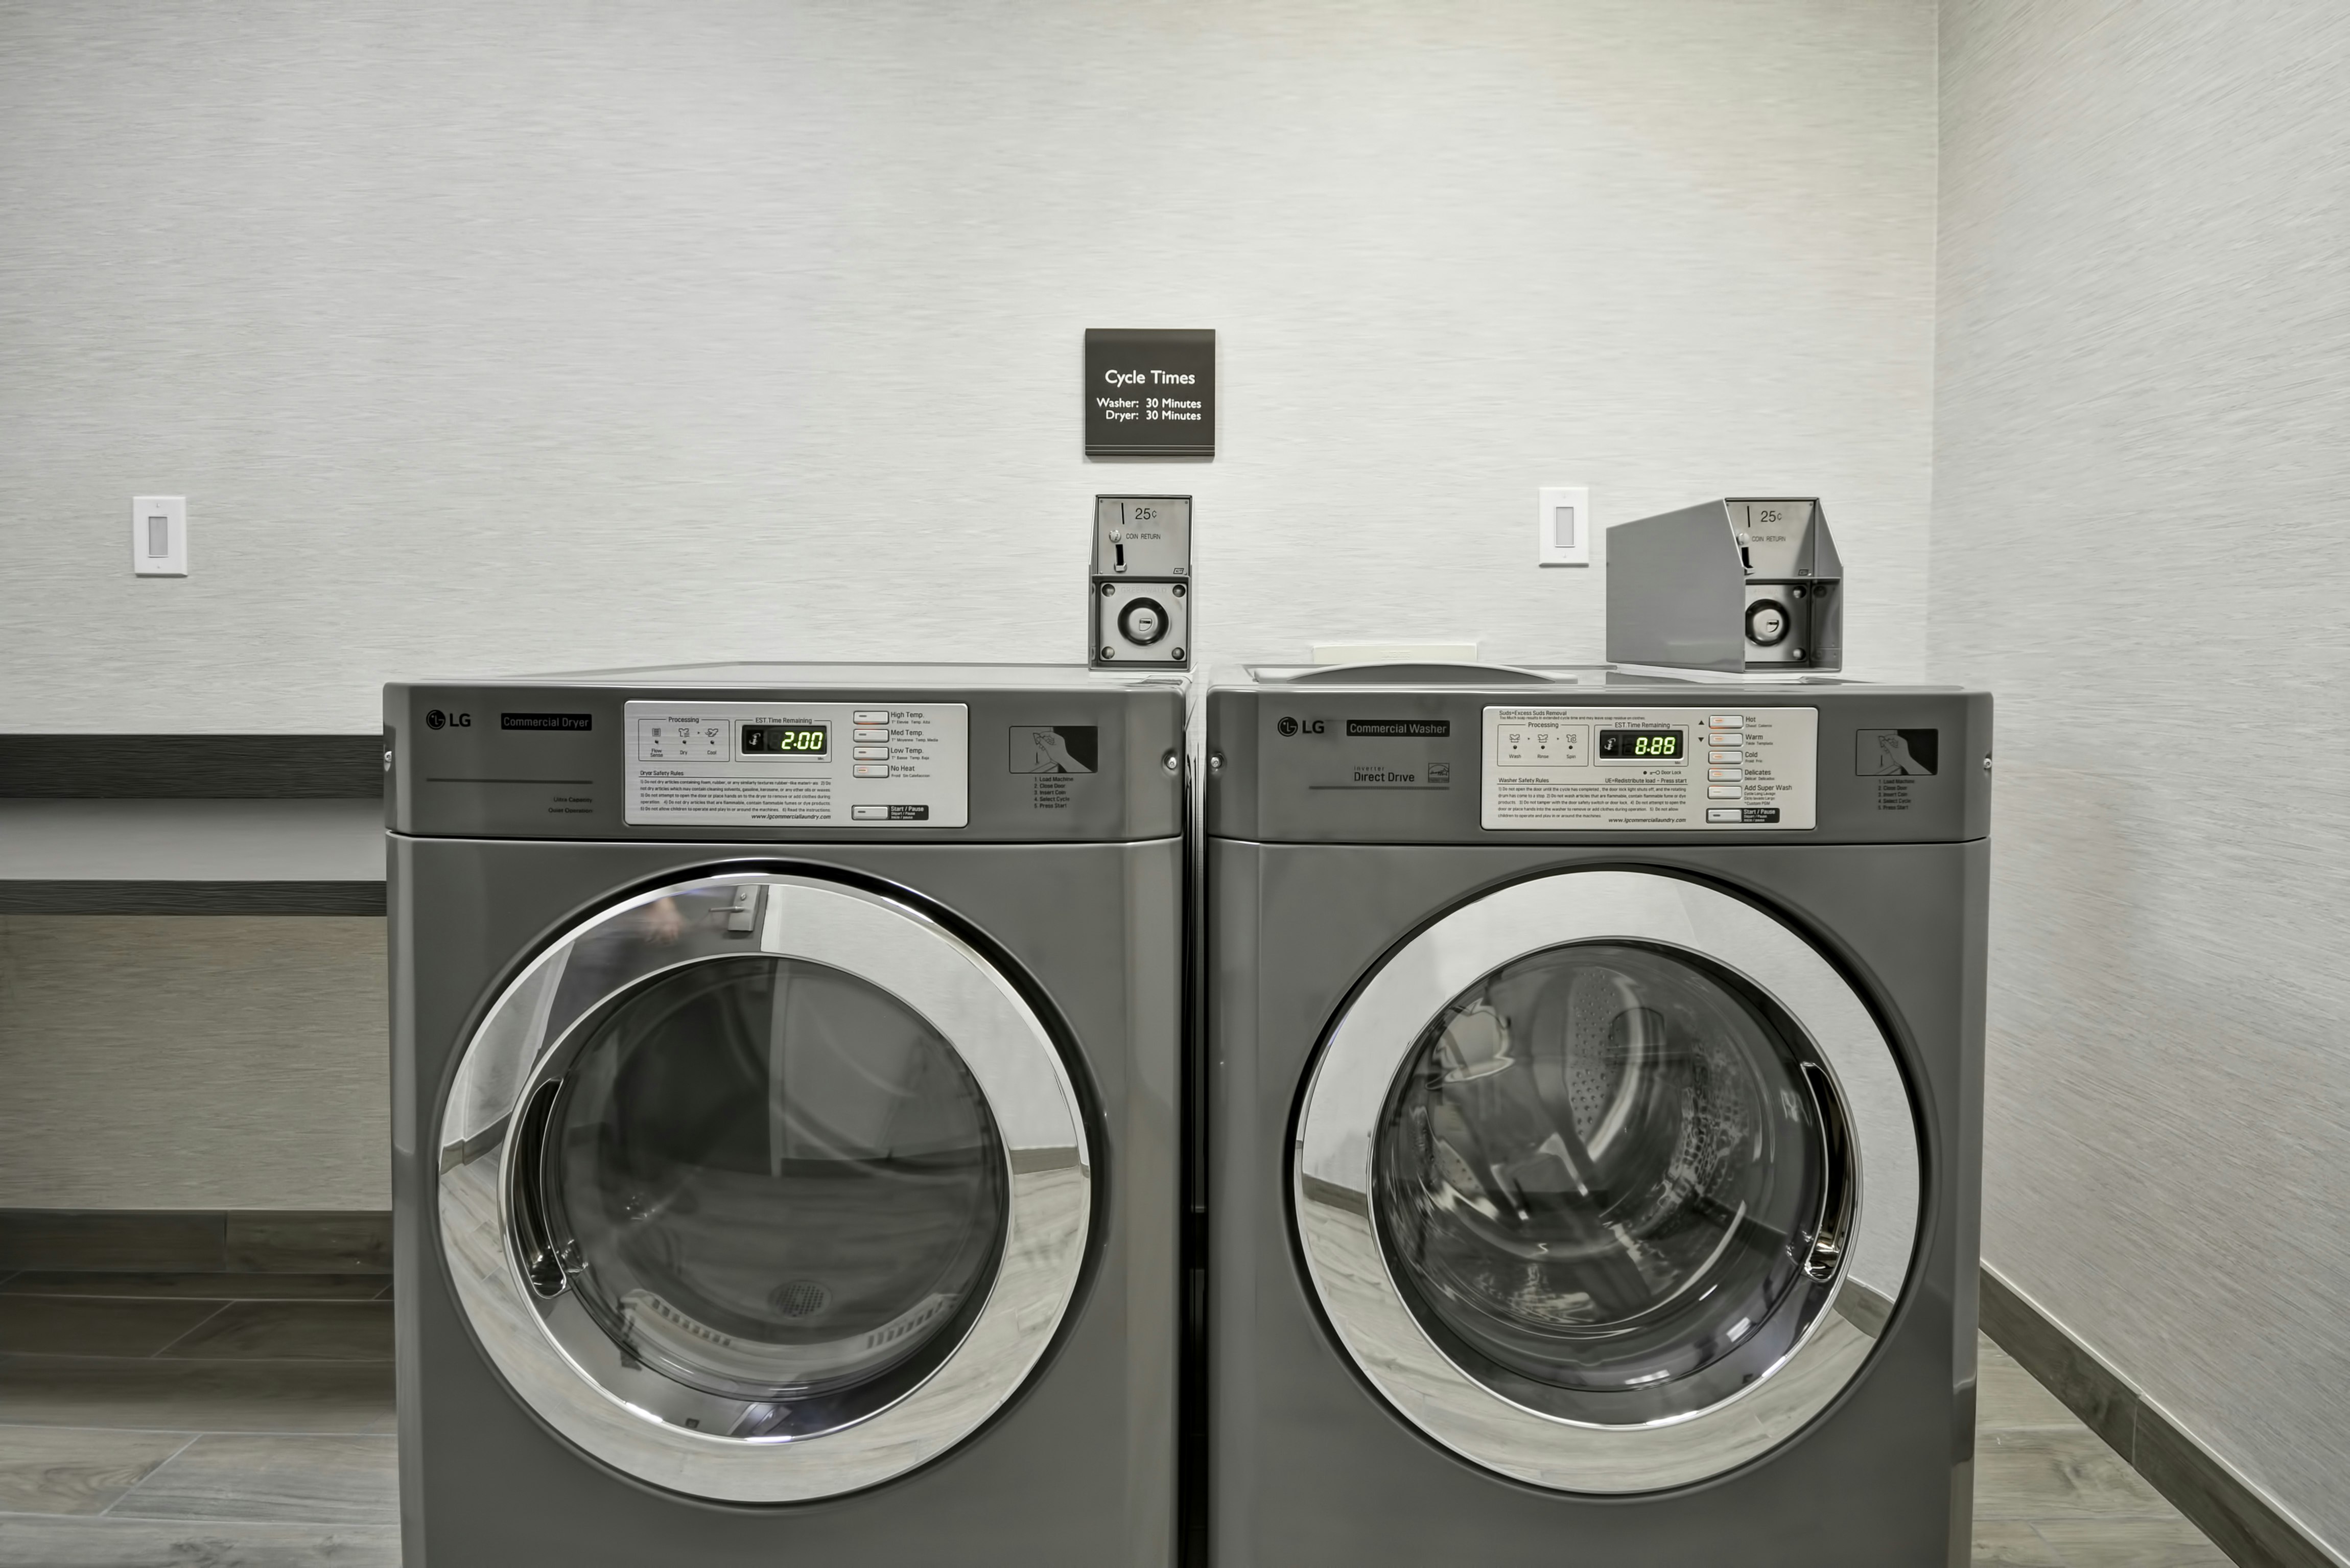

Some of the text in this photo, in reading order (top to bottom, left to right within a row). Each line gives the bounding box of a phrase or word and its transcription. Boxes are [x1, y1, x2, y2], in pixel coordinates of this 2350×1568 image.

[1105, 370, 1195, 387] Cycle Times
[1097, 398, 1201, 408] Washer: 30 Minutes
[1106, 410, 1201, 422] Dryer: 30 Minutes
[1135, 508, 1157, 520] 25¢
[1761, 510, 1782, 522] 25¢
[450, 713, 471, 727] LG
[504, 717, 589, 728] Commercial Dryer
[1302, 720, 1324, 734] LG
[1350, 723, 1446, 733] Commercial Washer
[782, 732, 823, 749] 2.00
[1354, 772, 1415, 782] Direct Drive
